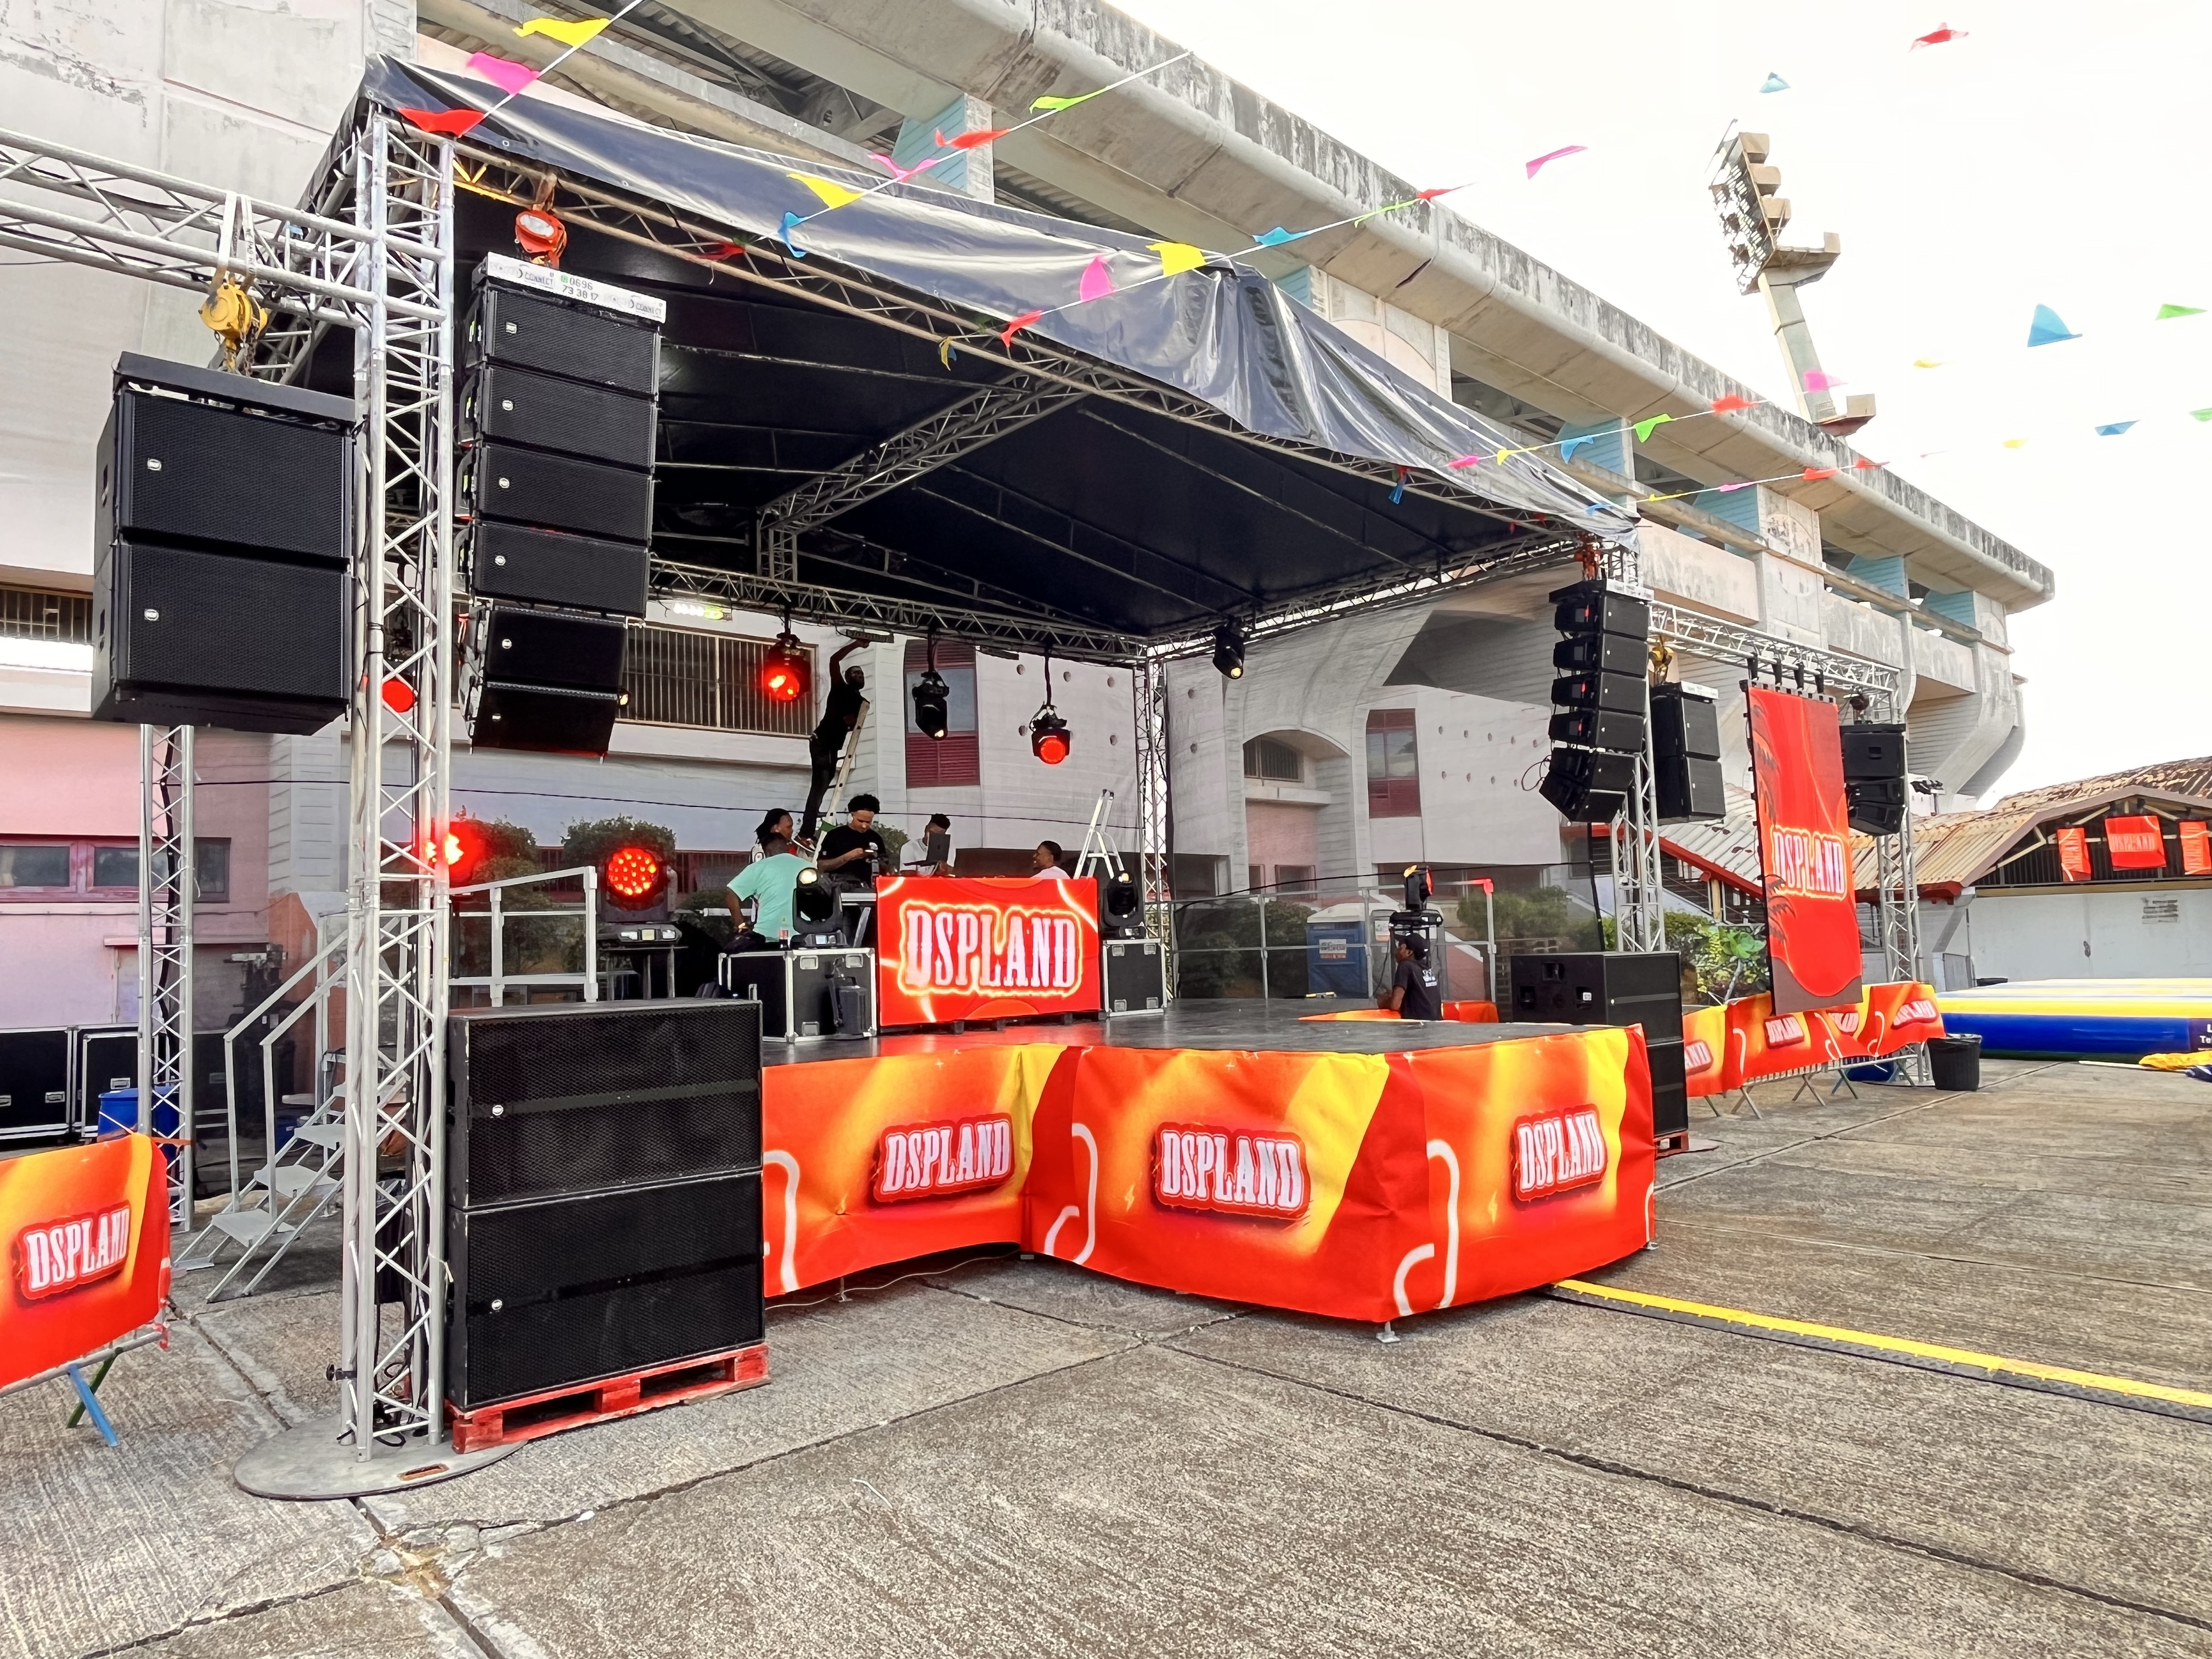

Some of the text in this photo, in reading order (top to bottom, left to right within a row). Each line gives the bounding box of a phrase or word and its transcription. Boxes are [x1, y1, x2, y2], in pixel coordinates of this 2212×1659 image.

[562, 285, 574, 295] 73
[577, 289, 588, 298] 38
[569, 278, 593, 290] 0696
[1773, 831, 1845, 894] DSPLAND
[905, 910, 1076, 988] DSPLAND
[882, 1121, 1011, 1192] DSPLAND
[1161, 1132, 1304, 1208] DSPLAND
[1518, 1113, 1605, 1190] DSPLAND
[26, 1207, 130, 1289] DSPLAND
